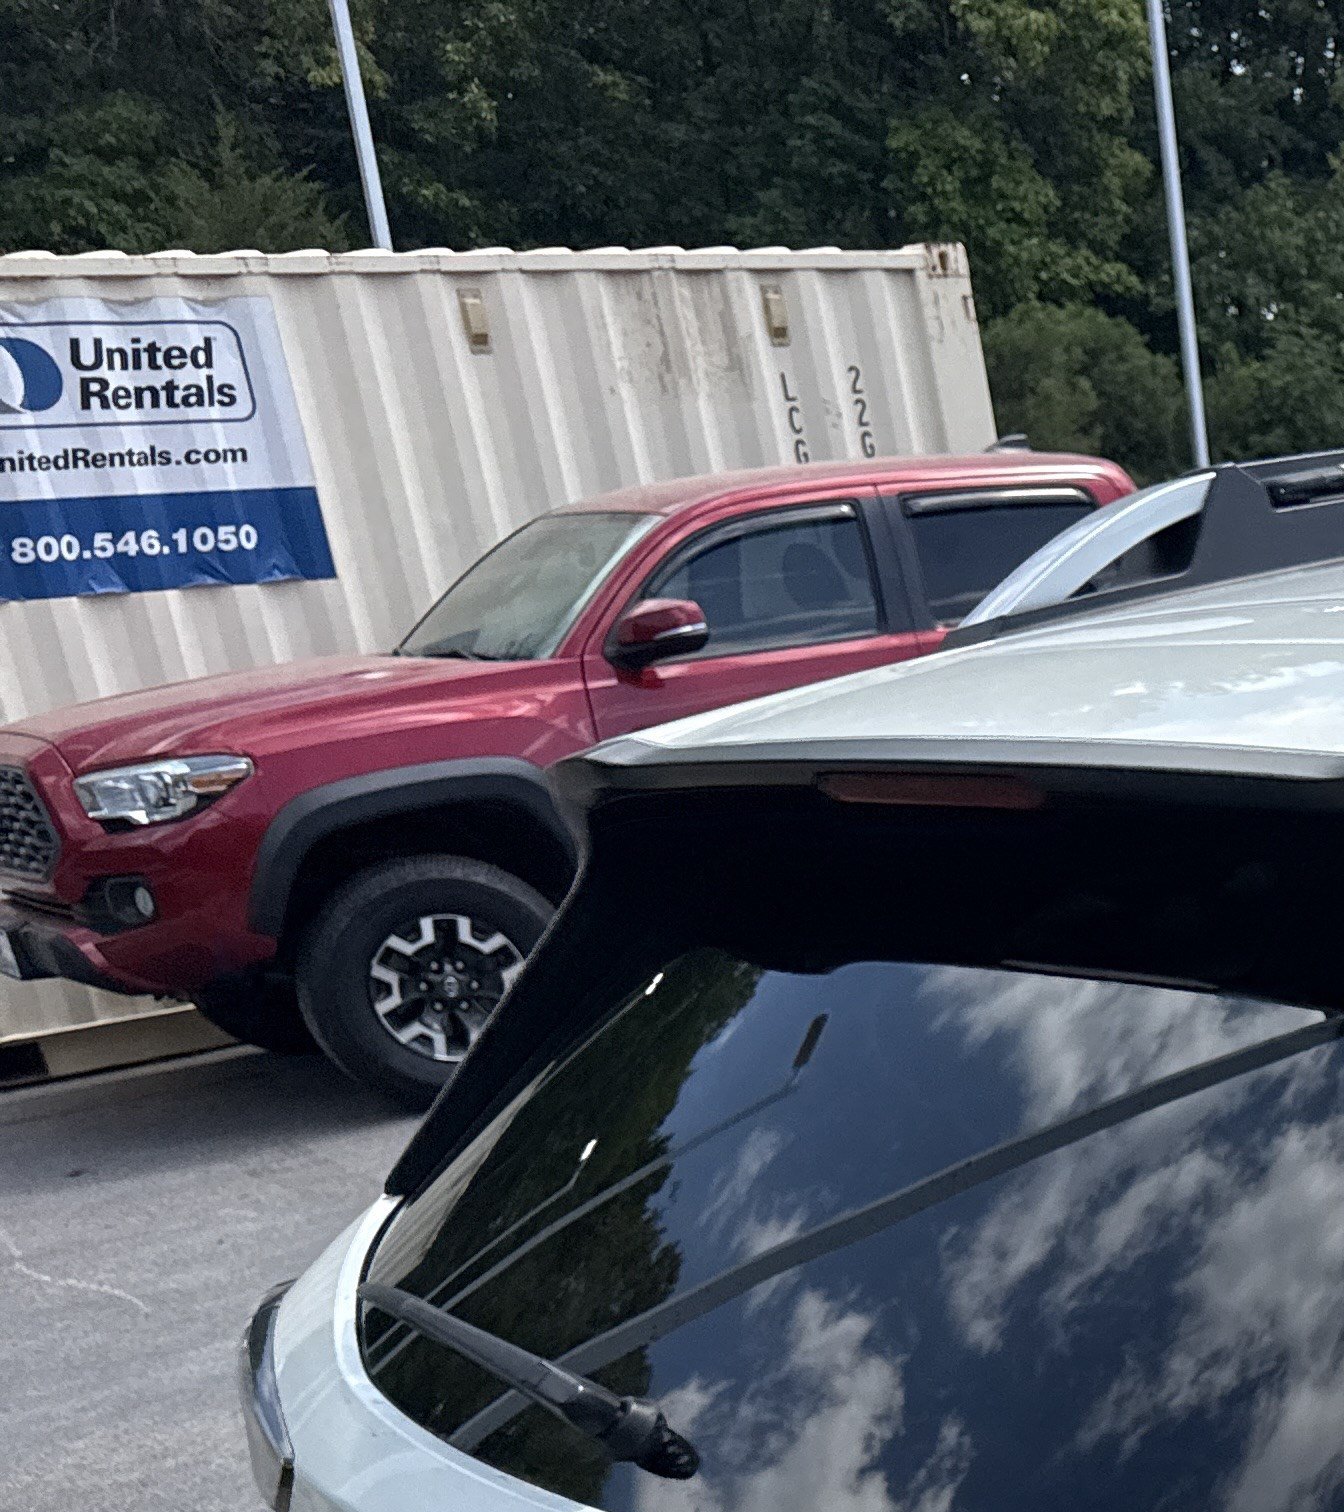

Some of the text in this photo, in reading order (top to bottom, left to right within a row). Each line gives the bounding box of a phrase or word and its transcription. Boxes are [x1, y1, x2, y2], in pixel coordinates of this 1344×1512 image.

[69, 337, 213, 371] United
[79, 375, 238, 411] Rentals
[11, 524, 258, 564] 800.546.1050
